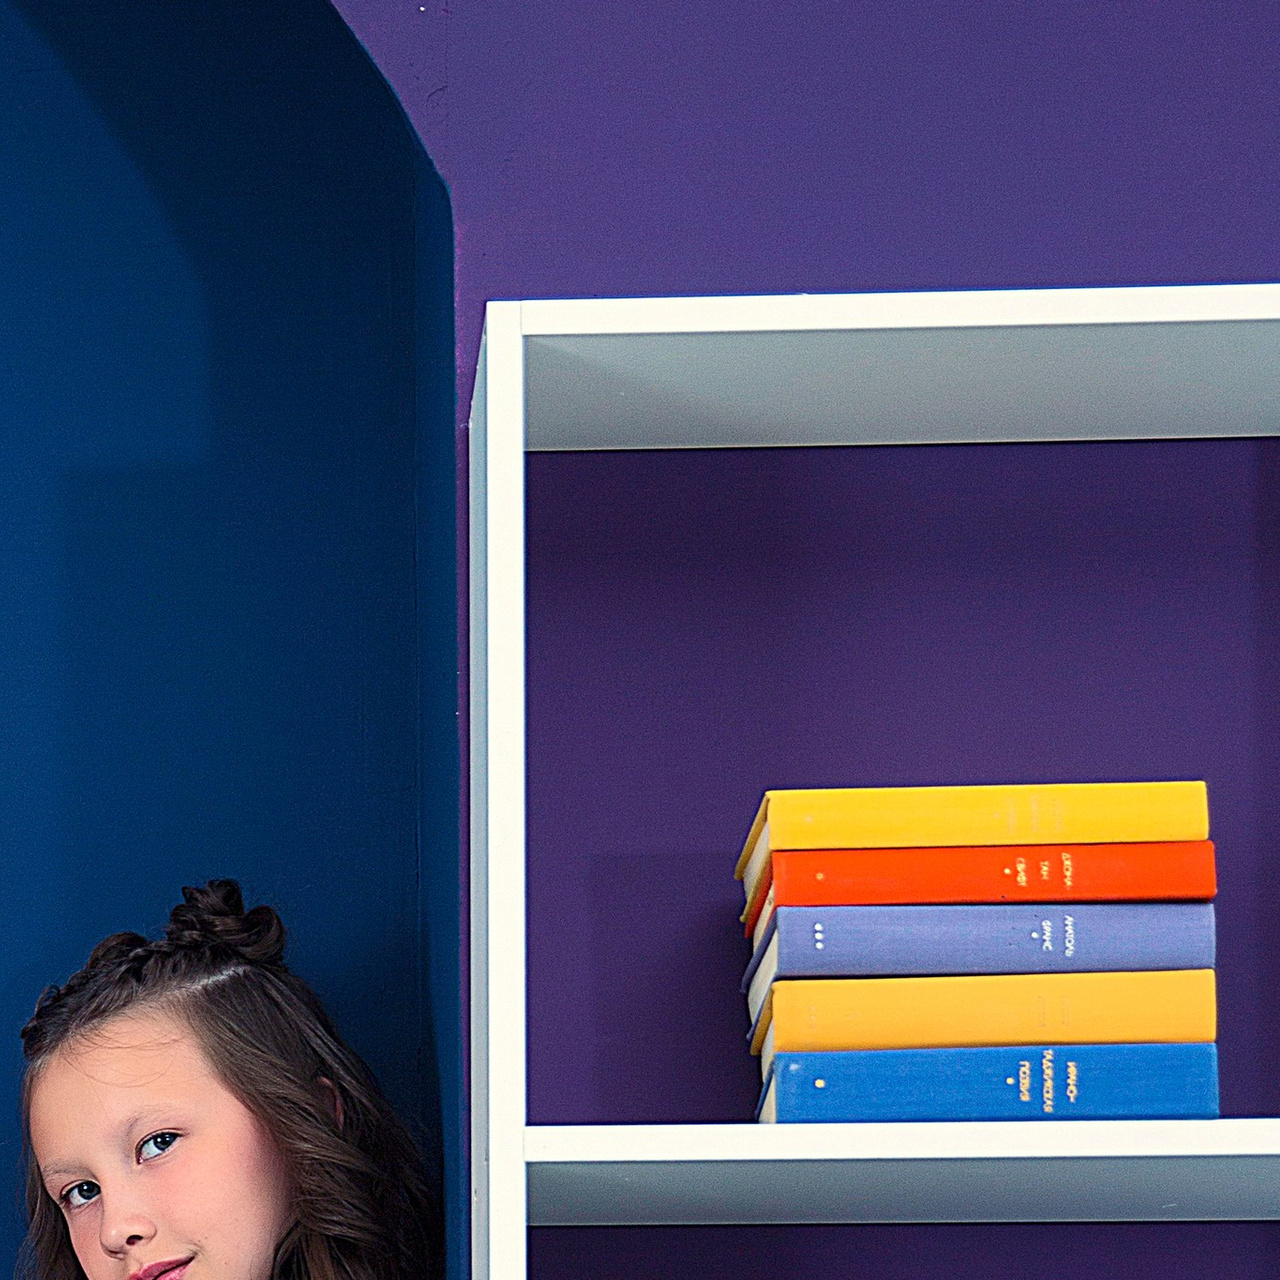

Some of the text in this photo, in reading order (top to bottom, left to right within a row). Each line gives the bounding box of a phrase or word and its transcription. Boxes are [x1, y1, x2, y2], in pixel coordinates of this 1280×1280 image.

[1016, 857, 1026, 887] СВИФТ
[1041, 861, 1049, 880] ТАН
[1041, 920, 1051, 951] ФРАНС
[1064, 915, 1074, 957] АНАТОЛЬ
[1020, 1061, 1030, 1101] ПОЭЗИЯ
[1044, 1050, 1055, 1113] ТАДЖИКСКАЯ
[1067, 1062, 1076, 1103] ИРАНО-
